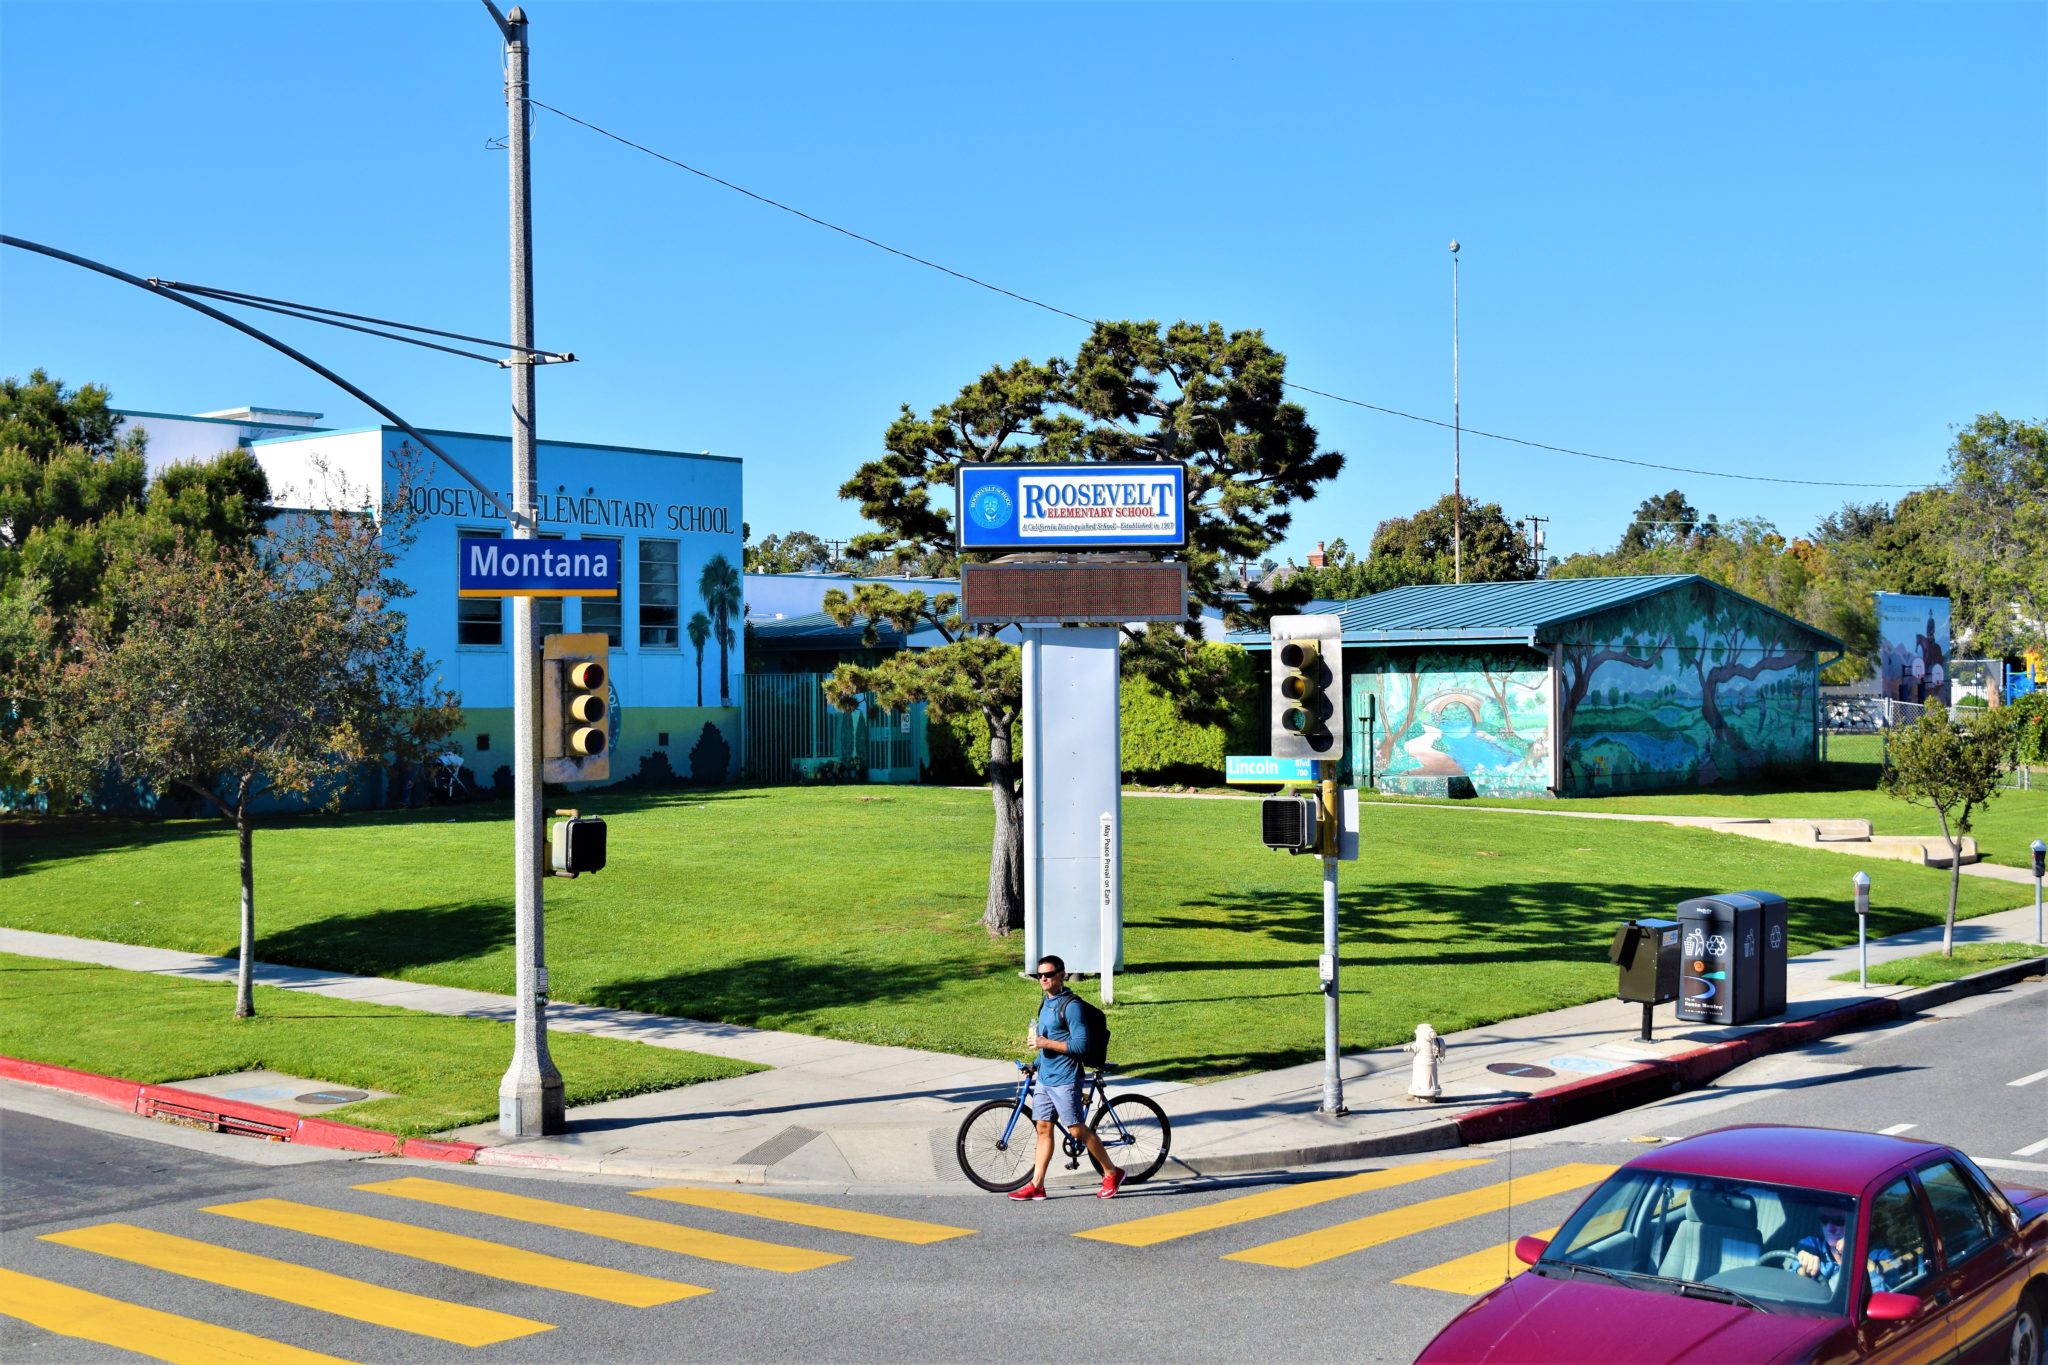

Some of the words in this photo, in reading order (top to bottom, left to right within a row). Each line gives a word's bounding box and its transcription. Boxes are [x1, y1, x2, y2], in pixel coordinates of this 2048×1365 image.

[1022, 483, 1174, 519] ROOSEVELT
[667, 505, 735, 534] SCHOOL
[1047, 507, 1114, 519] ELEMENTARY
[1115, 507, 1156, 518] SCHOOL
[1028, 523, 1057, 533] California
[1120, 521, 1153, 531] Established
[471, 545, 608, 577] Montana
[1229, 759, 1278, 775] Lincoln
[1104, 880, 1110, 888] on
